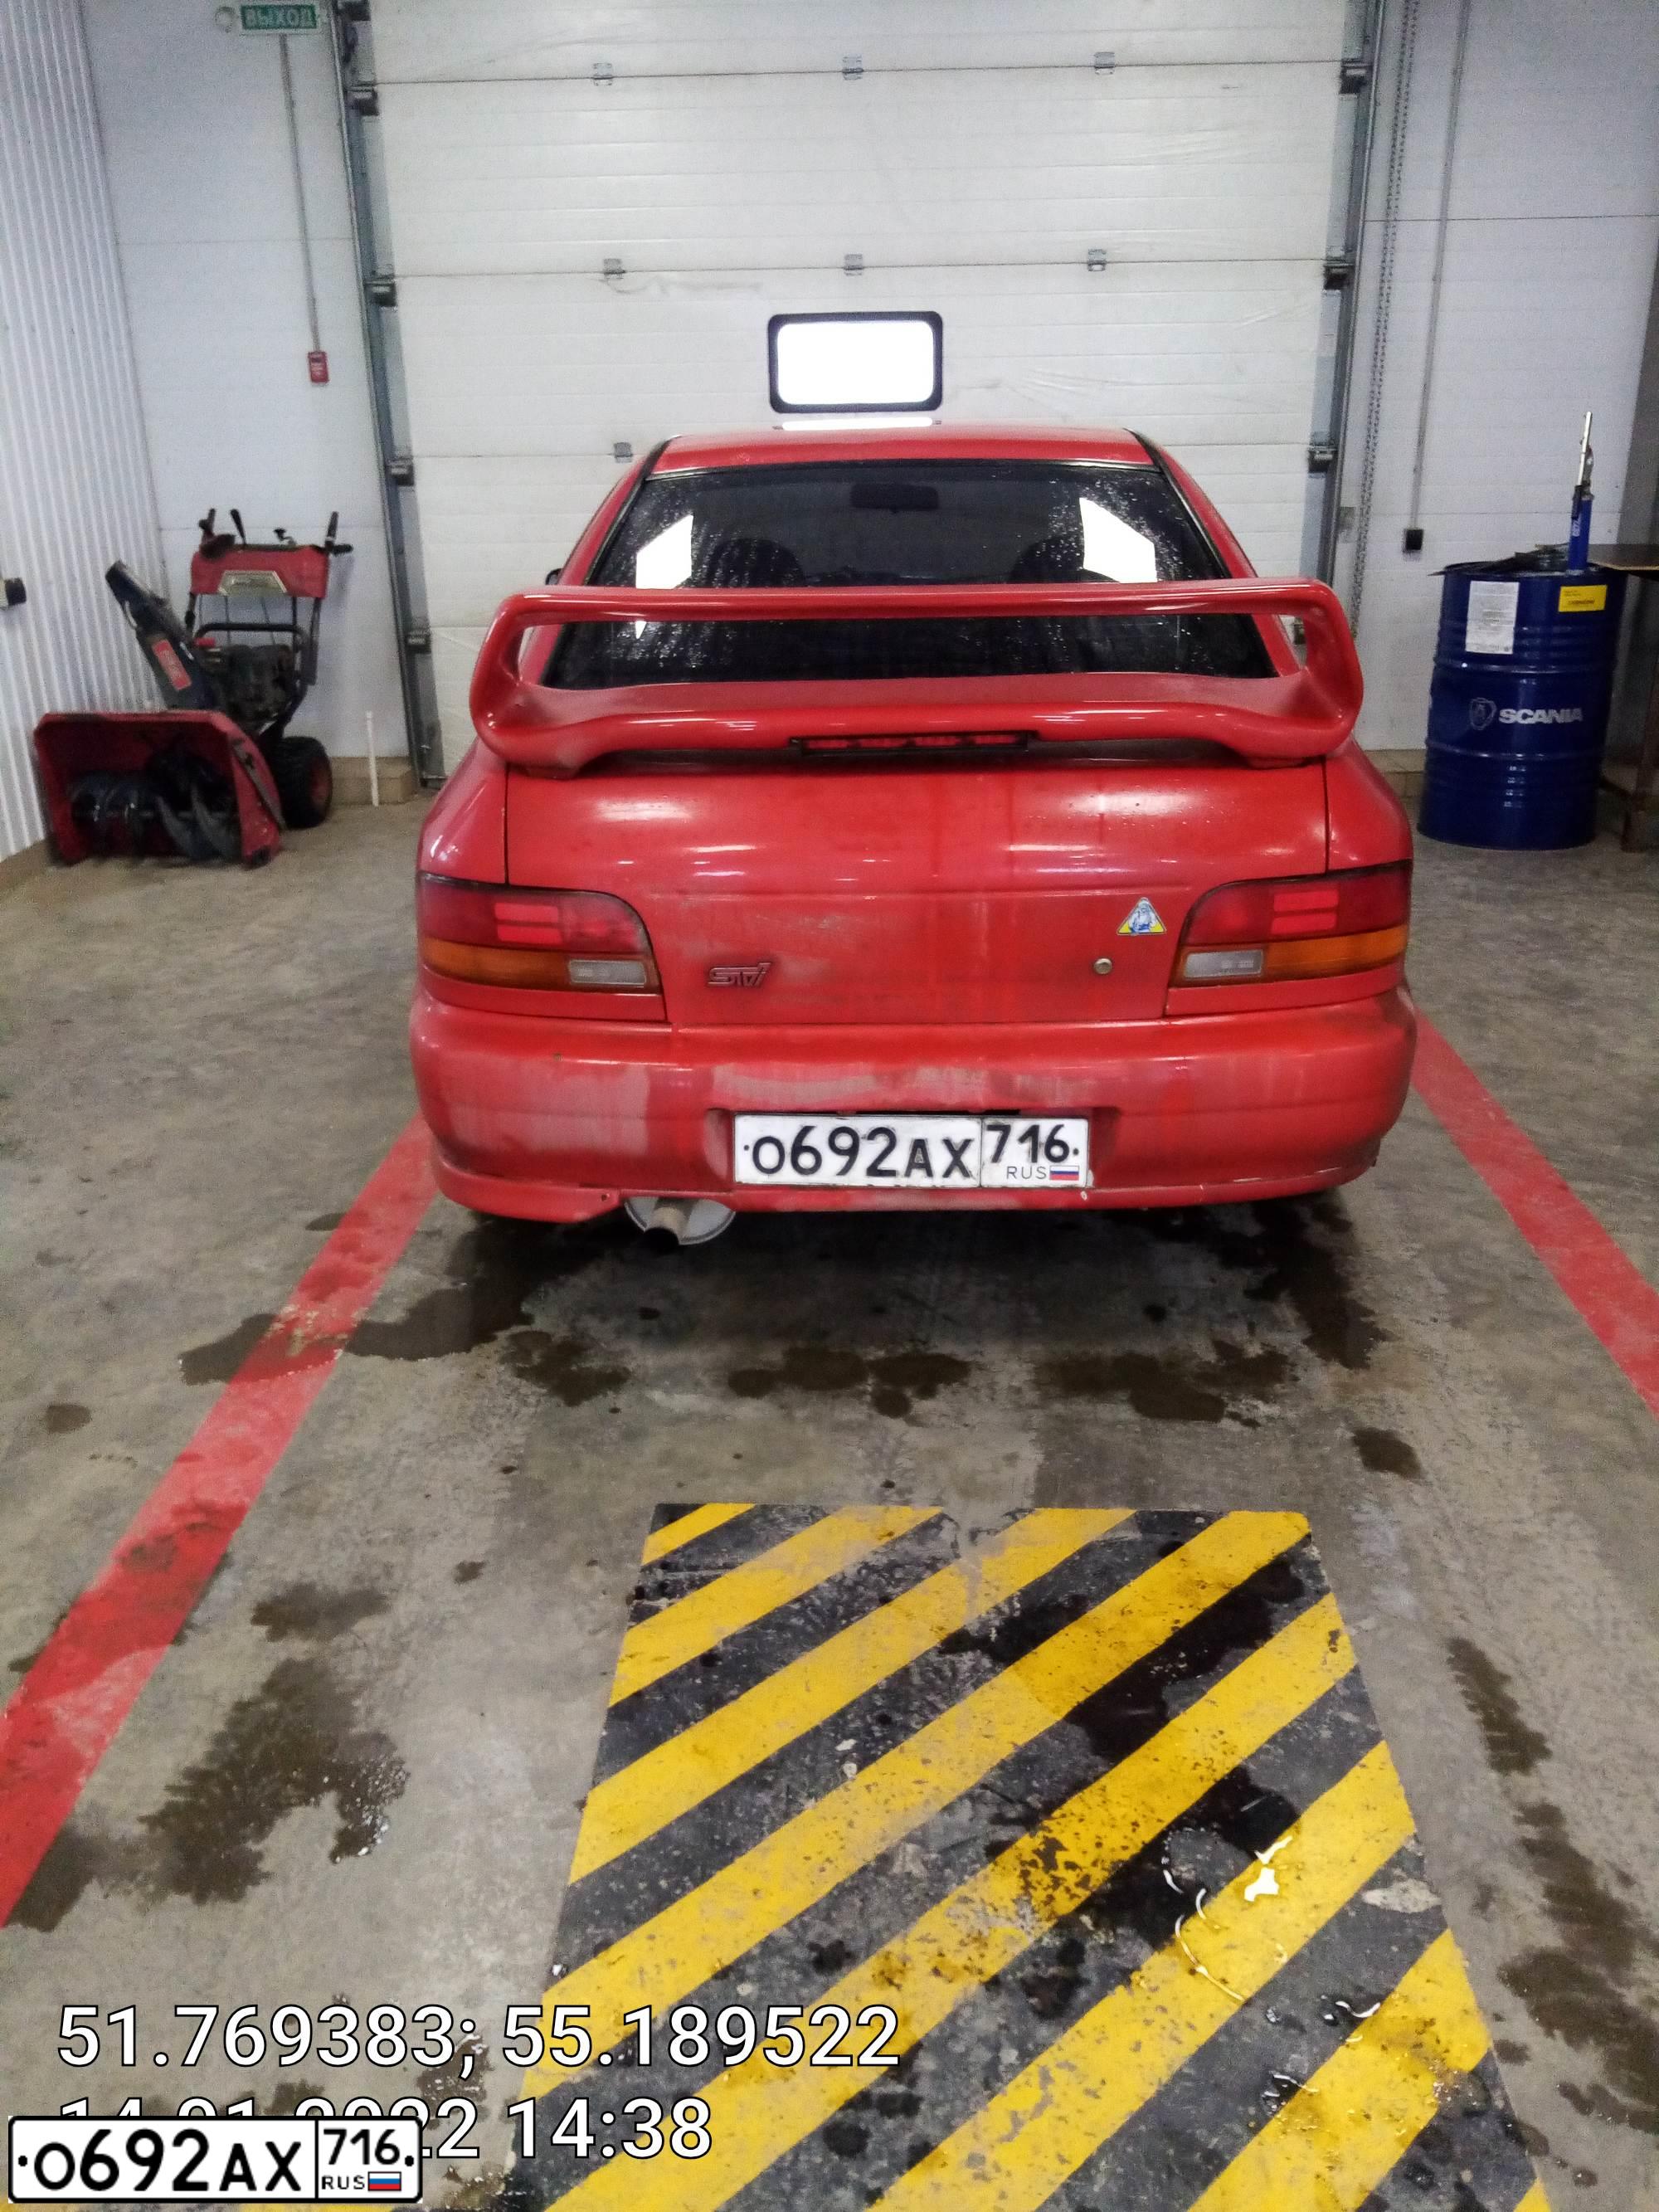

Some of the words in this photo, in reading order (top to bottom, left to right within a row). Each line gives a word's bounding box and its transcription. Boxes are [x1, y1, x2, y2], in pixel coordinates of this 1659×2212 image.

[245, 7, 314, 27] ВЫХОД
[1498, 708, 1583, 724] SCANIA
[986, 1123, 1070, 1163] 716
[1006, 1165, 1047, 1180] RUS
